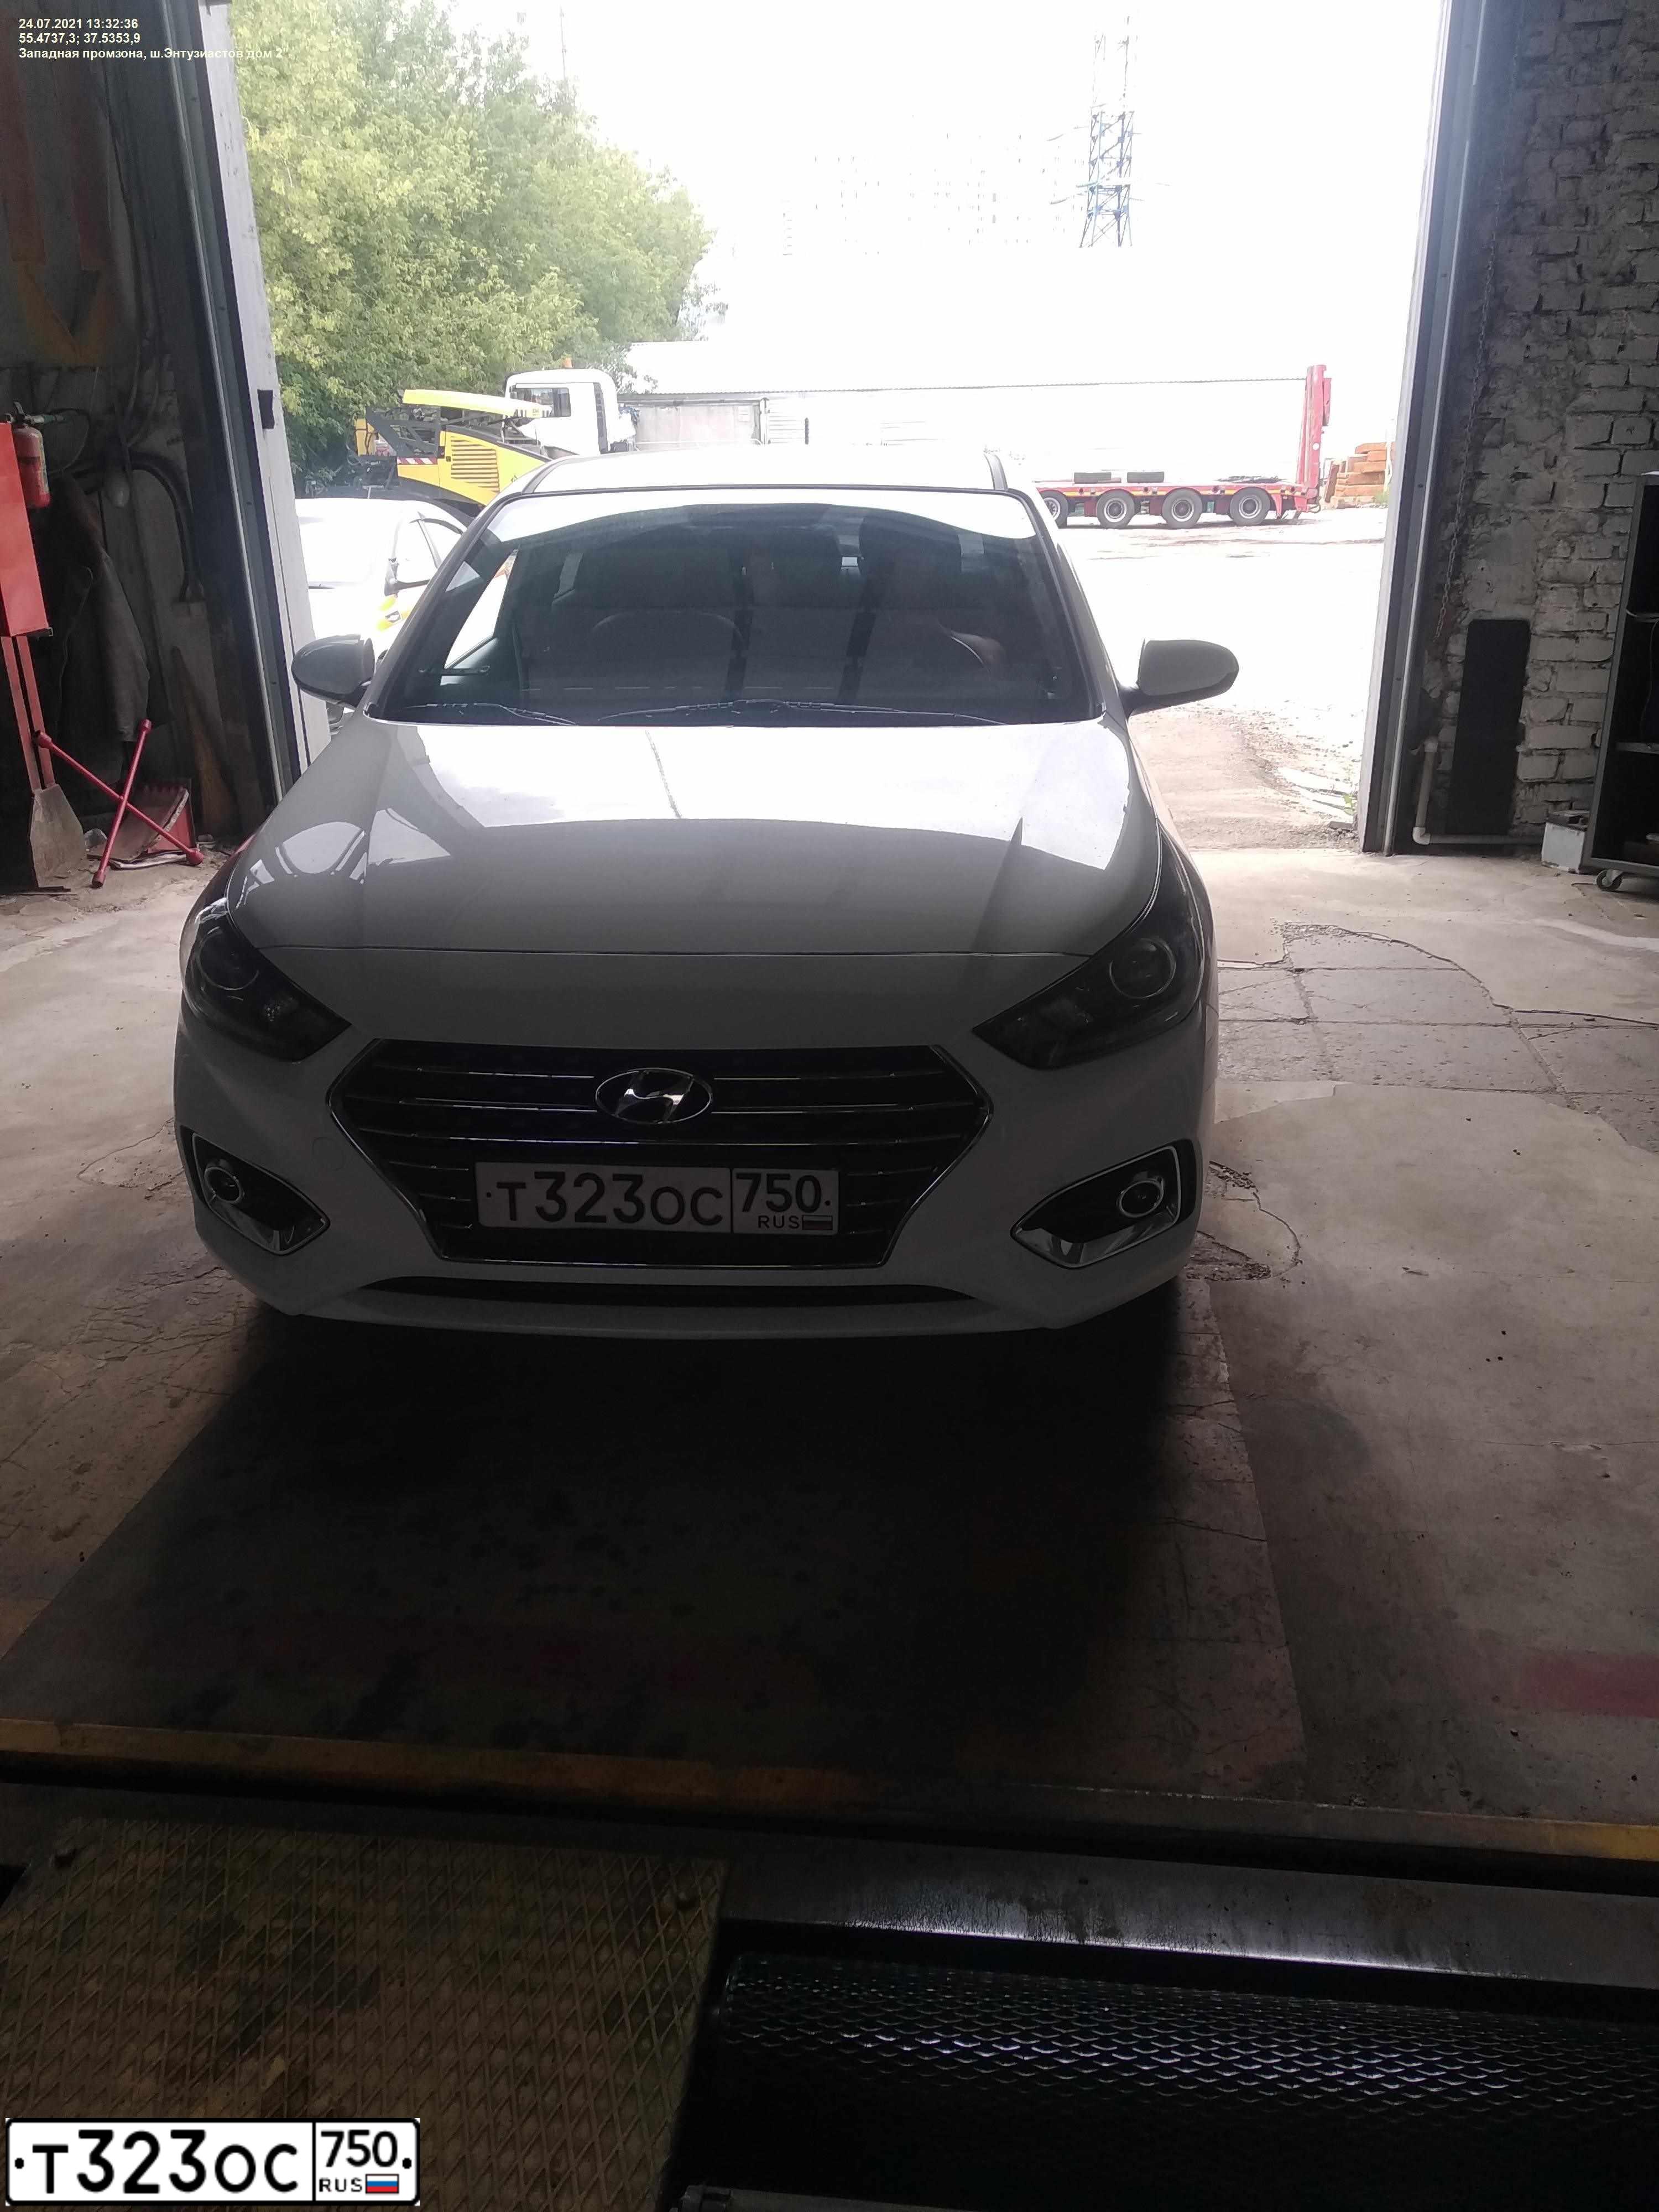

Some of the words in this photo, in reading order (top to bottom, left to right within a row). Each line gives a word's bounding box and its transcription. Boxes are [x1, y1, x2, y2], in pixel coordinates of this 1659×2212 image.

[497, 1171, 723, 1226] Т323ОС
[736, 1172, 822, 1213] 750
[758, 1215, 800, 1229] RUS
